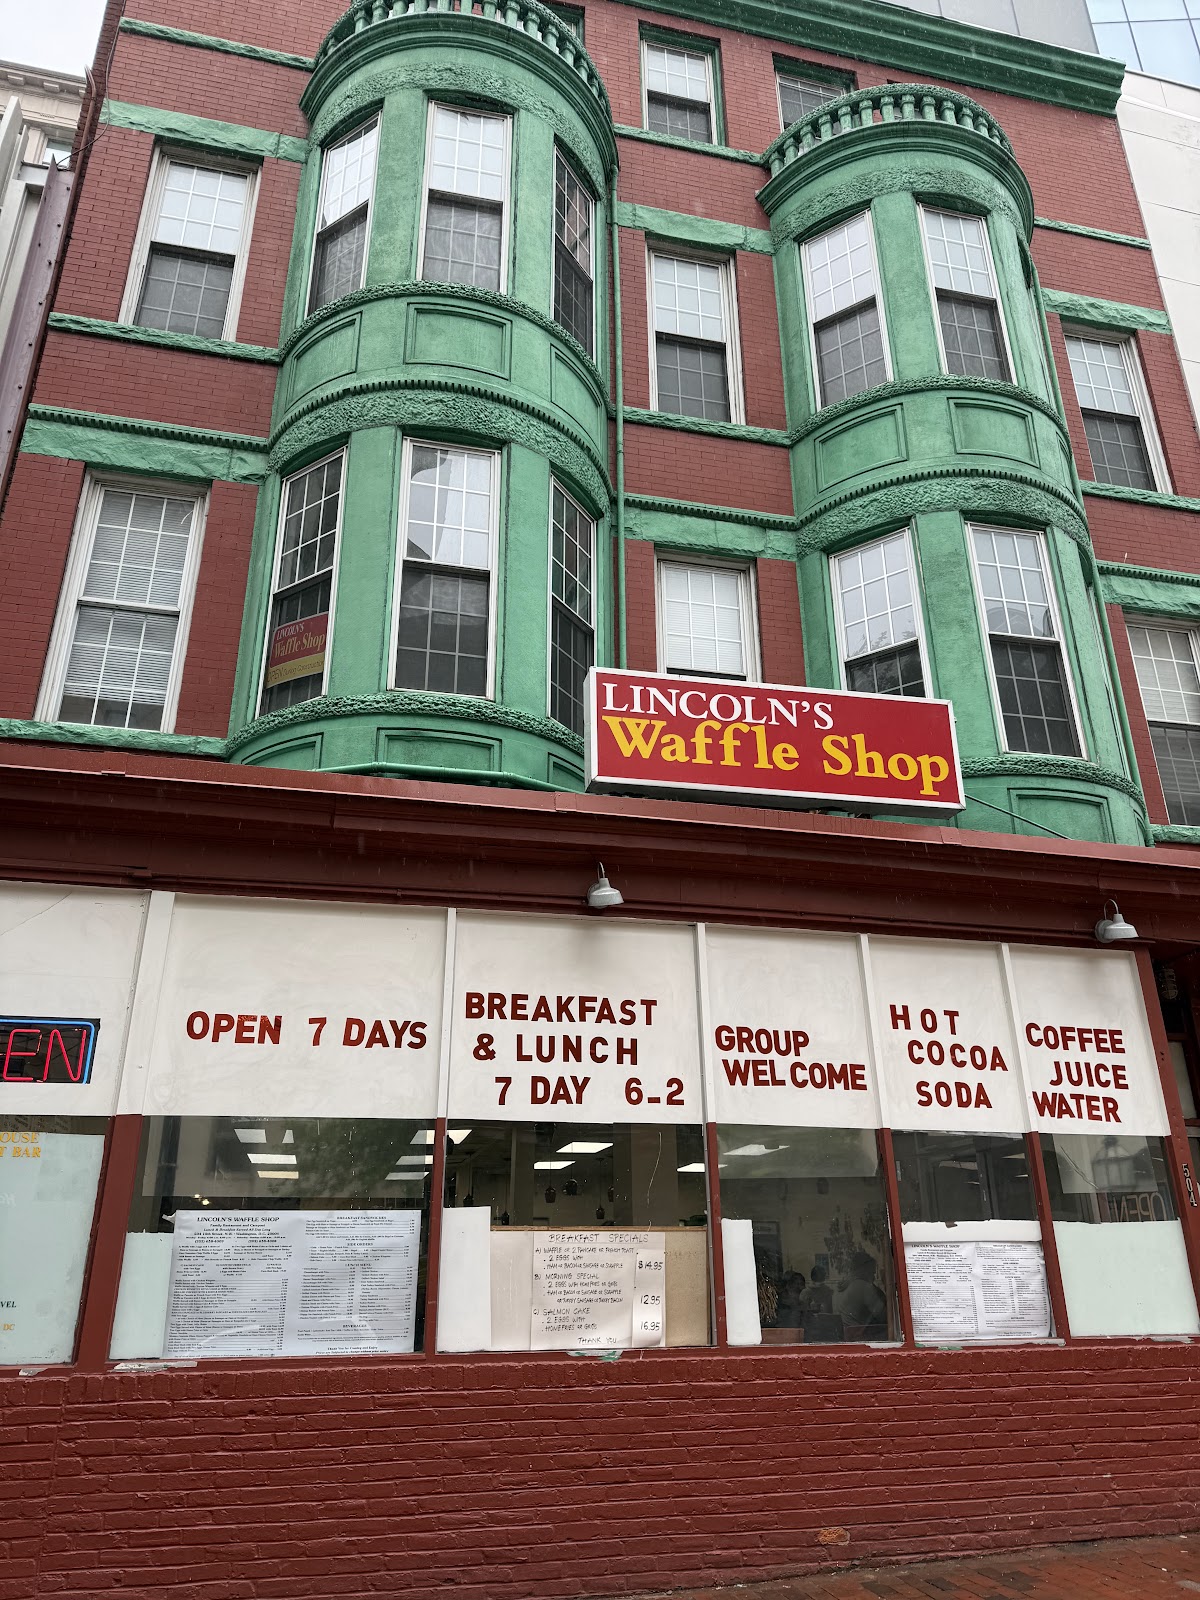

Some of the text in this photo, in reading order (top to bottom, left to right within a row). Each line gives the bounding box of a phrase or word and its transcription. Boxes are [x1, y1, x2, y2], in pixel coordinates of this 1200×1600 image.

[274, 632, 326, 658] Waffle Shop
[278, 623, 304, 640] LINCOLN'S
[602, 682, 833, 730] LINCOLN'S
[602, 715, 949, 796] Waffle Shop
[466, 991, 658, 1026] BREAKFAST
[889, 1004, 960, 1035] HOT
[186, 1010, 428, 1050] OPEN 7 DAYS
[714, 1024, 810, 1057] GROUP
[1025, 1022, 1126, 1054] COFFEE
[472, 1033, 638, 1066] & LUNCH
[907, 1040, 1009, 1072] COCOA
[494, 1076, 512, 1106] 7
[530, 1075, 591, 1105] DAY
[722, 1059, 868, 1091] WELCOME
[1049, 1060, 1129, 1090] JUICE
[915, 1080, 993, 1109] SODA
[1031, 1090, 1122, 1123] WATER
[12, 1146, 42, 1158] BAR
[1182, 1163, 1198, 1207] 504
[549, 1234, 649, 1243] BREAKFAST SPECIALS
[638, 1260, 663, 1270] $14.95
